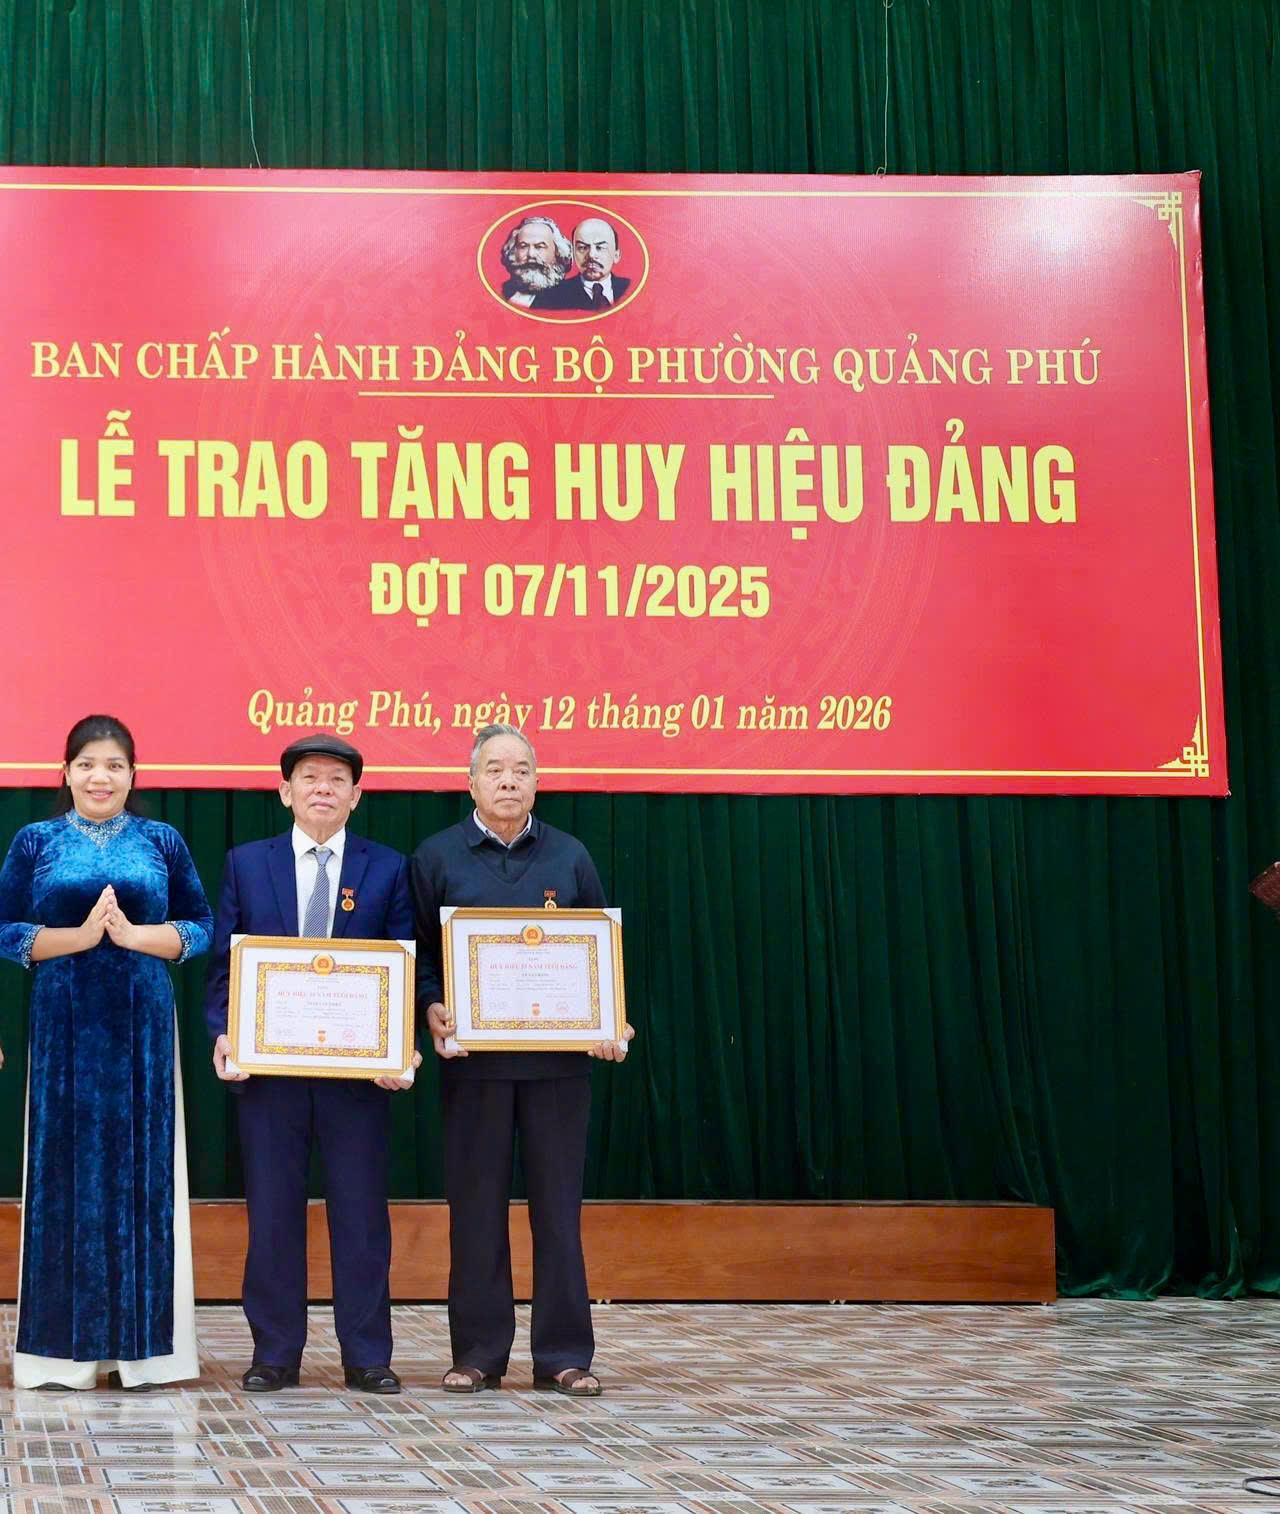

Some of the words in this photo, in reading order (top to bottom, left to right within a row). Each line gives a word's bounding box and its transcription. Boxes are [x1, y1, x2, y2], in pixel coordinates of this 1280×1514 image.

[31, 341, 123, 378] BAN
[136, 326, 258, 380] CHẤP
[271, 331, 400, 381] HÀNH
[412, 330, 540, 383] ĐẢNG
[552, 335, 614, 394] BỘ
[627, 333, 820, 384] PHƯỜNG
[833, 333, 992, 393] QUẢNG
[1007, 337, 1101, 385] PHÚ
[60, 409, 136, 517] LỄ
[158, 439, 328, 519] TRAO
[350, 423, 530, 538] TẶNG
[554, 443, 686, 521] HUY
[710, 427, 864, 540] HIỆU
[886, 418, 1077, 523] ĐẢNG
[368, 557, 468, 628] ĐỢT
[484, 562, 771, 618] 07/11/2025
[247, 687, 359, 736] Quảng
[367, 690, 441, 735] Phú,
[451, 691, 533, 736] ngày
[539, 695, 576, 730] 12
[587, 693, 684, 738] tháng
[691, 695, 725, 730] 01
[736, 694, 809, 731] năm
[816, 695, 893, 731] 2026
